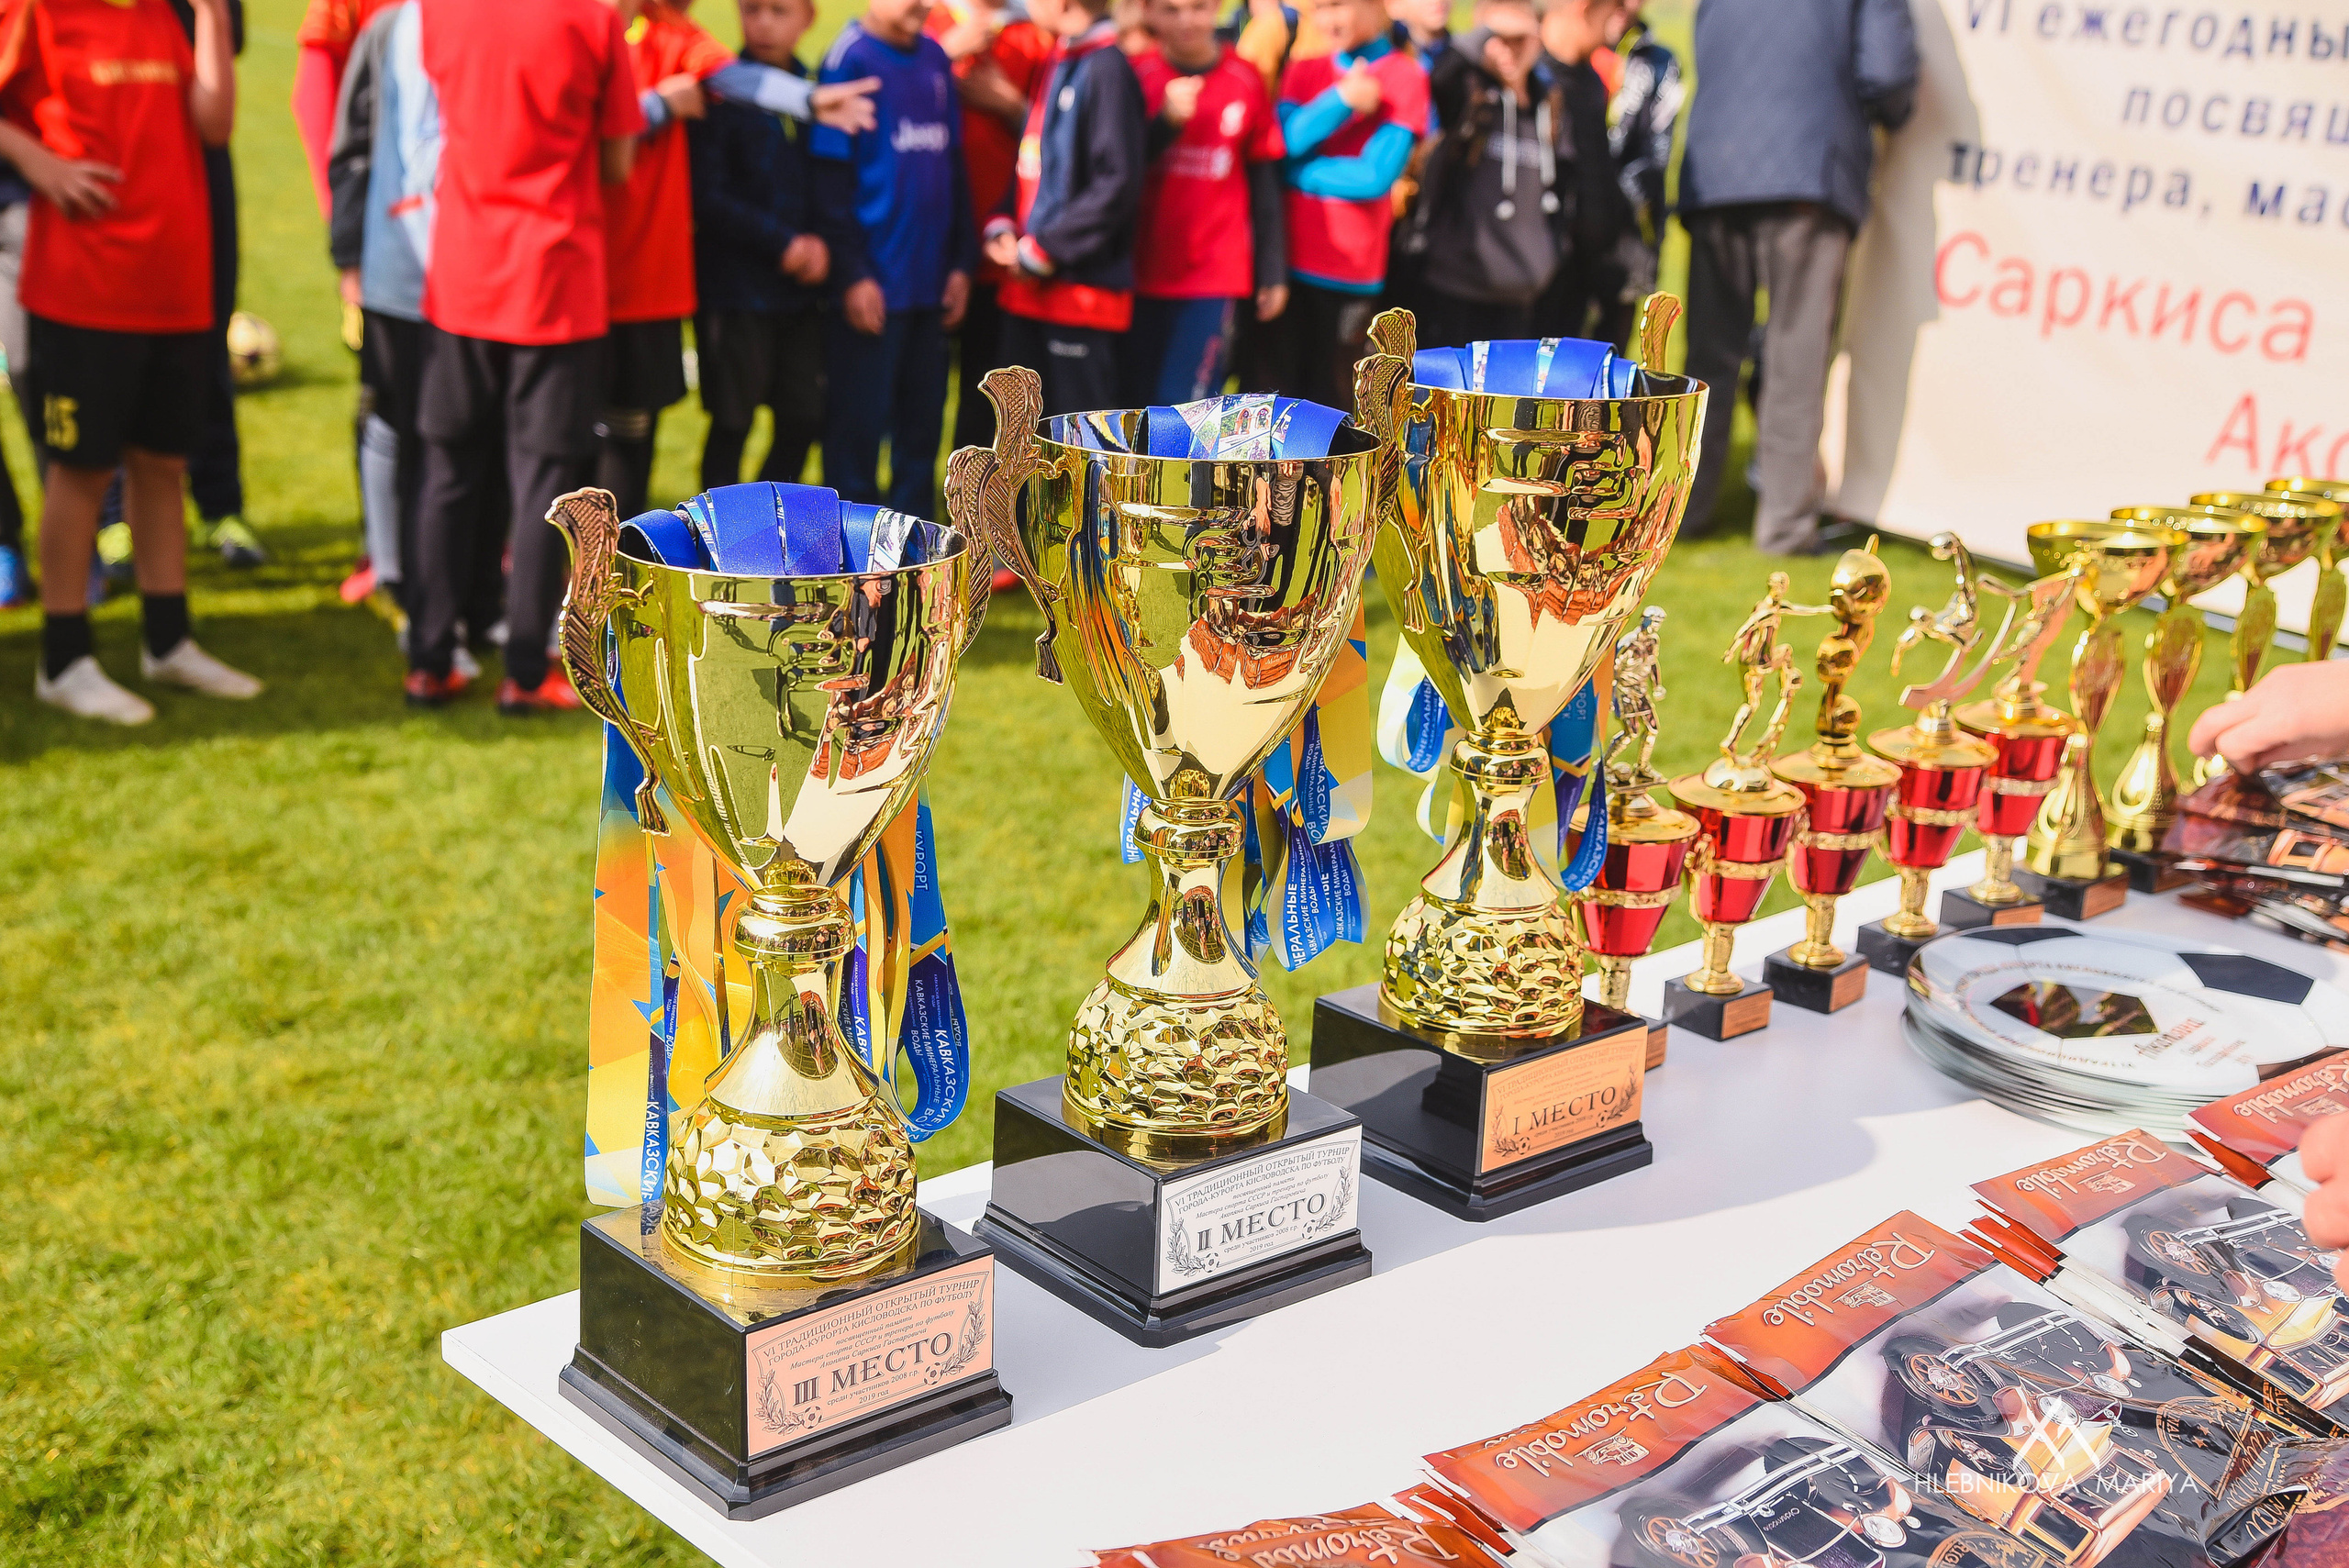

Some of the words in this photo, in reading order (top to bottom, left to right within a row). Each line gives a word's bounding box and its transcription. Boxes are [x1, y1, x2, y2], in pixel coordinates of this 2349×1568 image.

[1935, 229, 2318, 363] Саркиса
[1305, 743, 1315, 770] ВОДЫ
[1307, 821, 1322, 842] ВО
[1296, 837, 1308, 903] МИНЕРАЛЬНЫЕ
[1341, 869, 1352, 896] ВОДЫ
[1308, 885, 1319, 914] ВОДЫ
[665, 1034, 674, 1060] ВОДЫ
[910, 1029, 923, 1056] ВОДЫ
[915, 979, 930, 1040] КАВКАЗСКИЕ
[923, 1041, 941, 1104] МИНЕРАЛЬНЫЕ
[934, 1029, 957, 1124] КАВКАЗСКИЕ
[1513, 1116, 1520, 1135] I
[1529, 1086, 1616, 1130] МЕСТО
[641, 1101, 660, 1200] КАВКАЗСКИЕ
[1174, 1196, 1185, 1207] VI
[1186, 1163, 1264, 1200] ТРАДИЦИОННЫЙ
[1266, 1150, 1315, 1172] ОТКРЫТЫЙ
[1317, 1147, 1350, 1160] ТУРНИР
[2015, 1135, 2168, 1200] Retromobile
[1178, 1182, 1244, 1214] ГОРОДА-КУРОРТА
[1245, 1165, 1299, 1187] КИСЛОВОДСКА
[1301, 1162, 1312, 1171] ПО
[1313, 1156, 1345, 1168] ФУТБОЛУ
[1196, 1206, 1223, 1219] Мастера
[1224, 1199, 1246, 1211] спорта
[1248, 1191, 1266, 1203] СССР
[1197, 1228, 1212, 1252] II
[1219, 1192, 1327, 1247] МЕСТО
[1223, 1243, 1241, 1253] среди
[1241, 1231, 1275, 1249] участников
[1249, 1243, 1264, 1253] 2019
[1264, 1240, 1275, 1250] год
[1762, 1231, 1936, 1327] Retromobile
[763, 1347, 775, 1358] VI
[778, 1304, 873, 1351] ТРАДИЦИОННЫЙ
[875, 1284, 937, 1312] ОТКРЫТЫЙ
[939, 1279, 980, 1295] ТУРНИР
[768, 1326, 850, 1366] ГОРОДА-КУРОРТА
[852, 1303, 918, 1330] КИСЛОВОДСКА
[919, 1298, 933, 1308] ПО
[934, 1290, 975, 1305] ФУТБОЛУ
[790, 1353, 824, 1370] Мастера
[825, 1344, 853, 1360] спорта
[854, 1334, 877, 1348] СССР
[884, 1323, 914, 1338] тренера
[925, 1308, 955, 1326] футболу
[885, 1315, 913, 1330] памяти
[793, 1375, 821, 1407] III
[829, 1331, 954, 1396] МЕСТО
[819, 1353, 850, 1369] Акопяна
[852, 1342, 882, 1358] Саркиса
[883, 1327, 928, 1348] Гаспаровича
[827, 1393, 848, 1407] среди
[849, 1379, 890, 1400] участников
[891, 1371, 907, 1383] 2008
[859, 1392, 876, 1405] 2019
[877, 1388, 890, 1399] год
[1494, 1371, 1709, 1478] Retromobile
